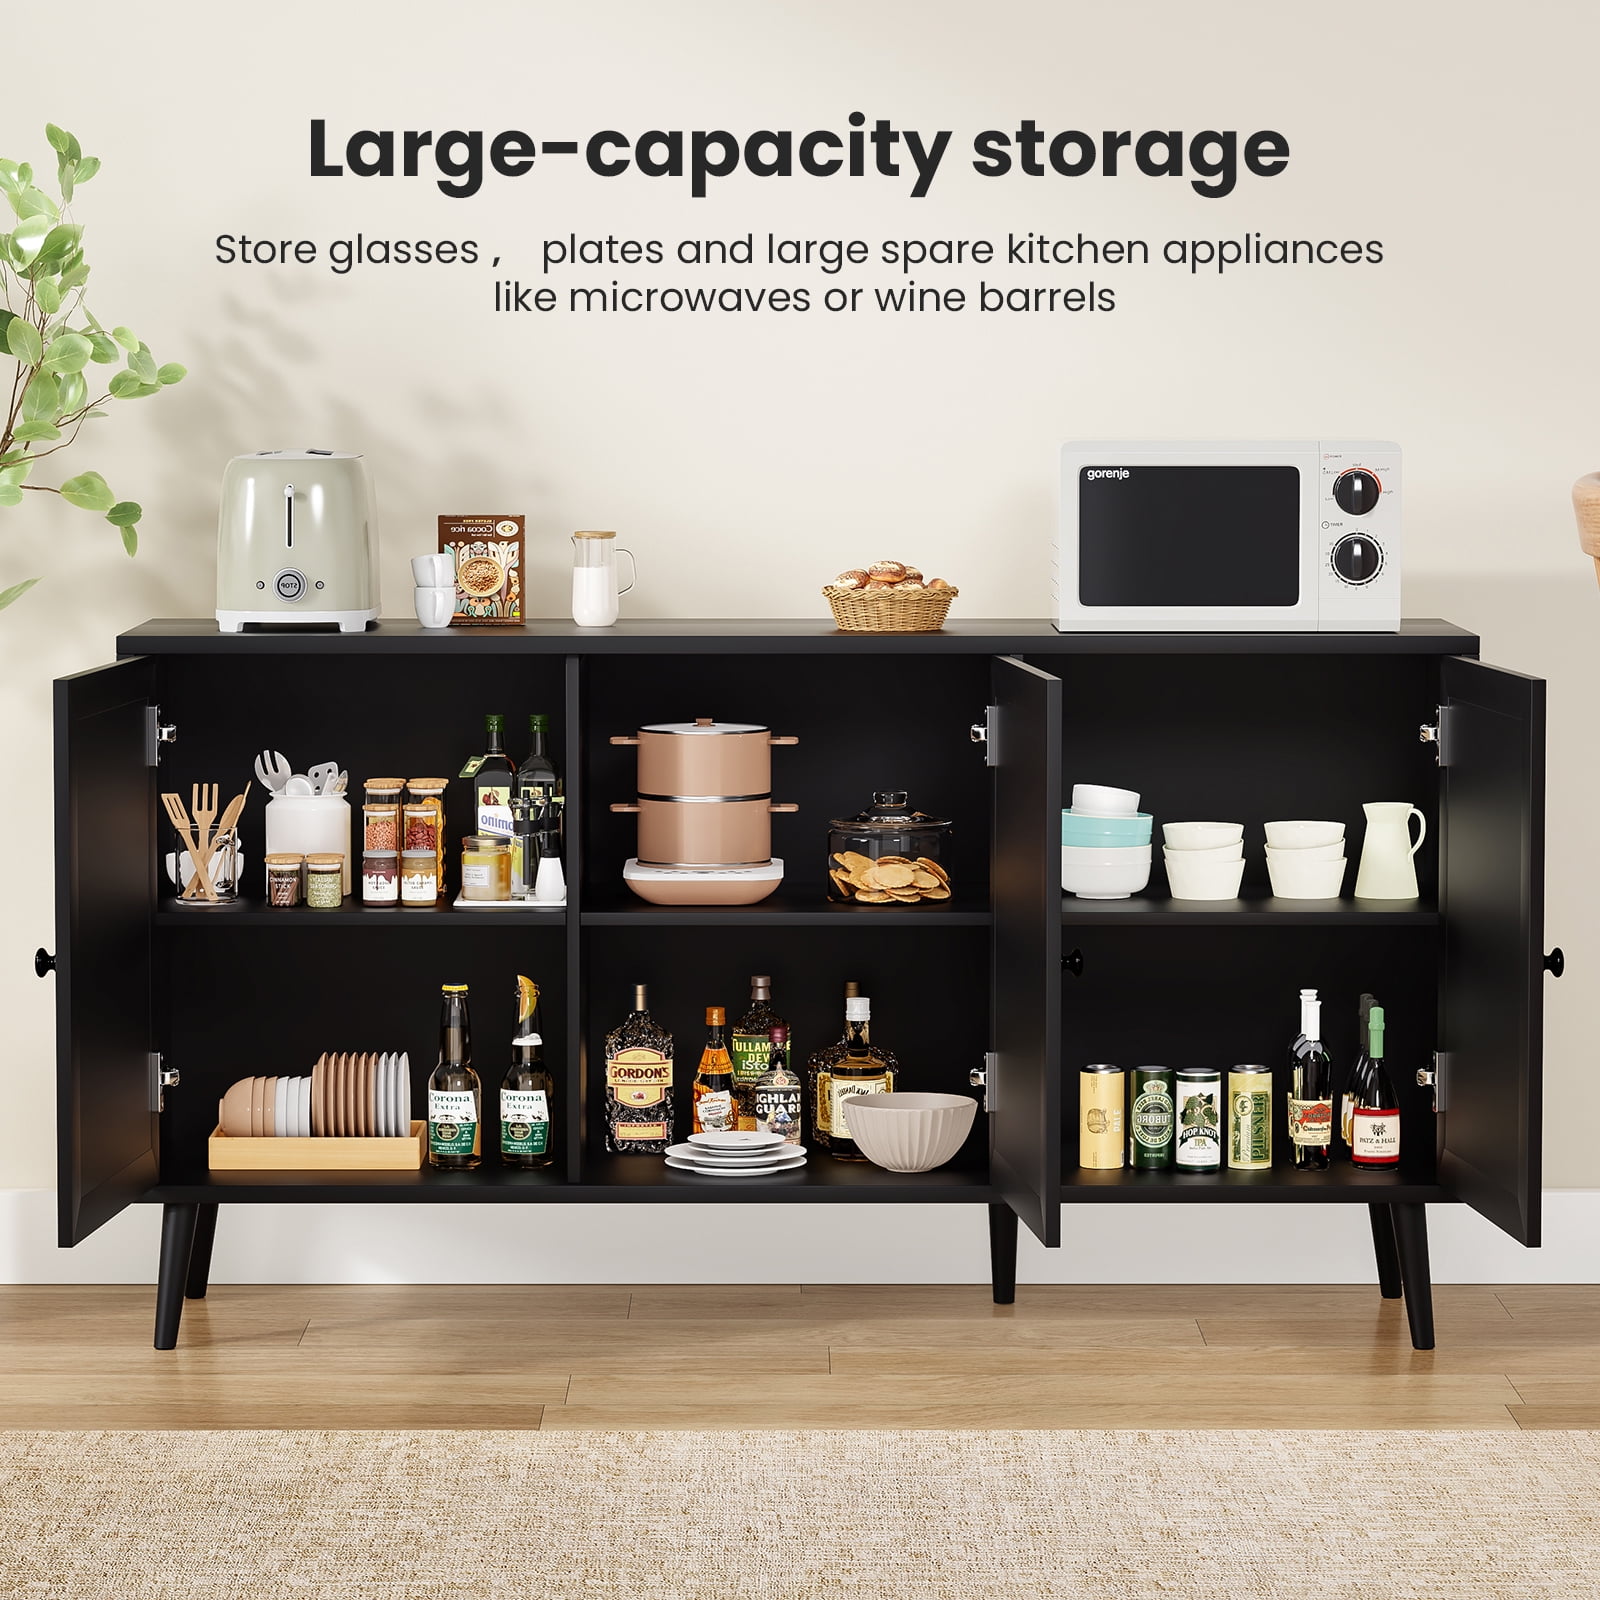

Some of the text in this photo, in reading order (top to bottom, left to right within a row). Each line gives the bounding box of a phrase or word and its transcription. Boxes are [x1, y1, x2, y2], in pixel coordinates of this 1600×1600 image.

[1087, 467, 1130, 481] gorenje
[611, 1066, 670, 1079] GORDON'S
[430, 1092, 470, 1102] Corona
[501, 1091, 542, 1101] Corona
[506, 1102, 533, 1110] Extra
[1113, 1109, 1121, 1133] PALE
[1252, 1095, 1265, 1159] PILSNER
[1182, 1128, 1217, 1139] HOP KNOT
[1194, 1138, 1207, 1147] IPA
